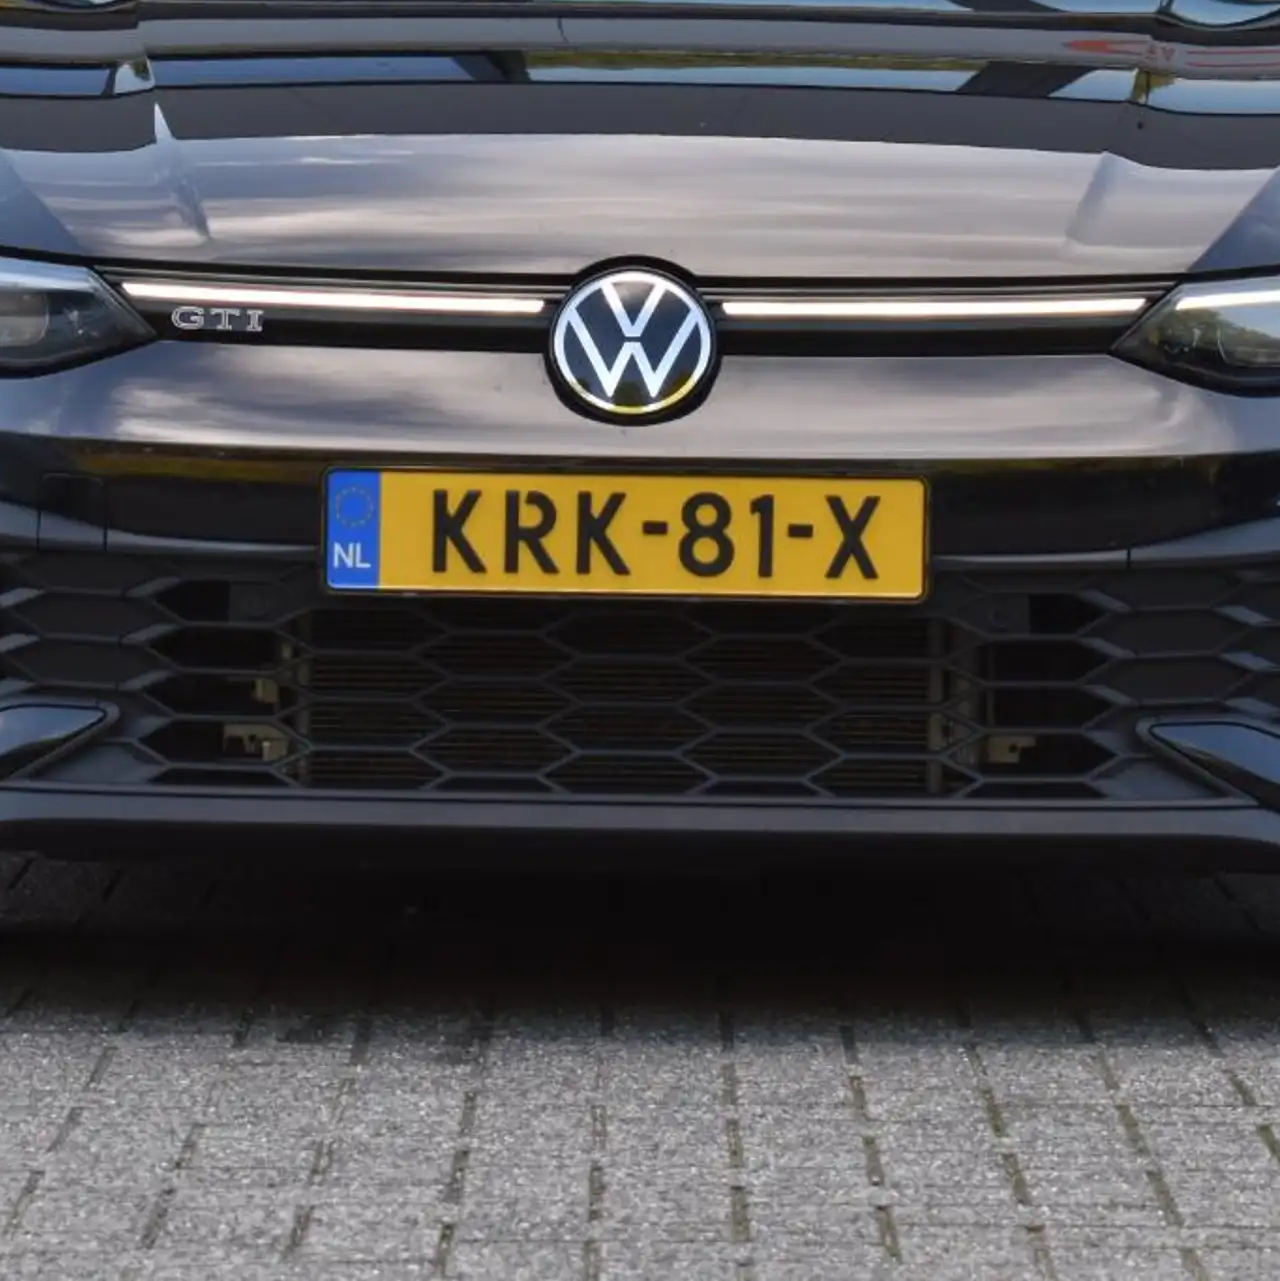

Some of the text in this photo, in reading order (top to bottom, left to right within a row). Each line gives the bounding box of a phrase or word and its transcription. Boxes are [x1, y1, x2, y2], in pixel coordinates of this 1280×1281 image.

[171, 305, 265, 332] GTI
[431, 488, 881, 581] KRK-81-X
[332, 541, 372, 570] NL
